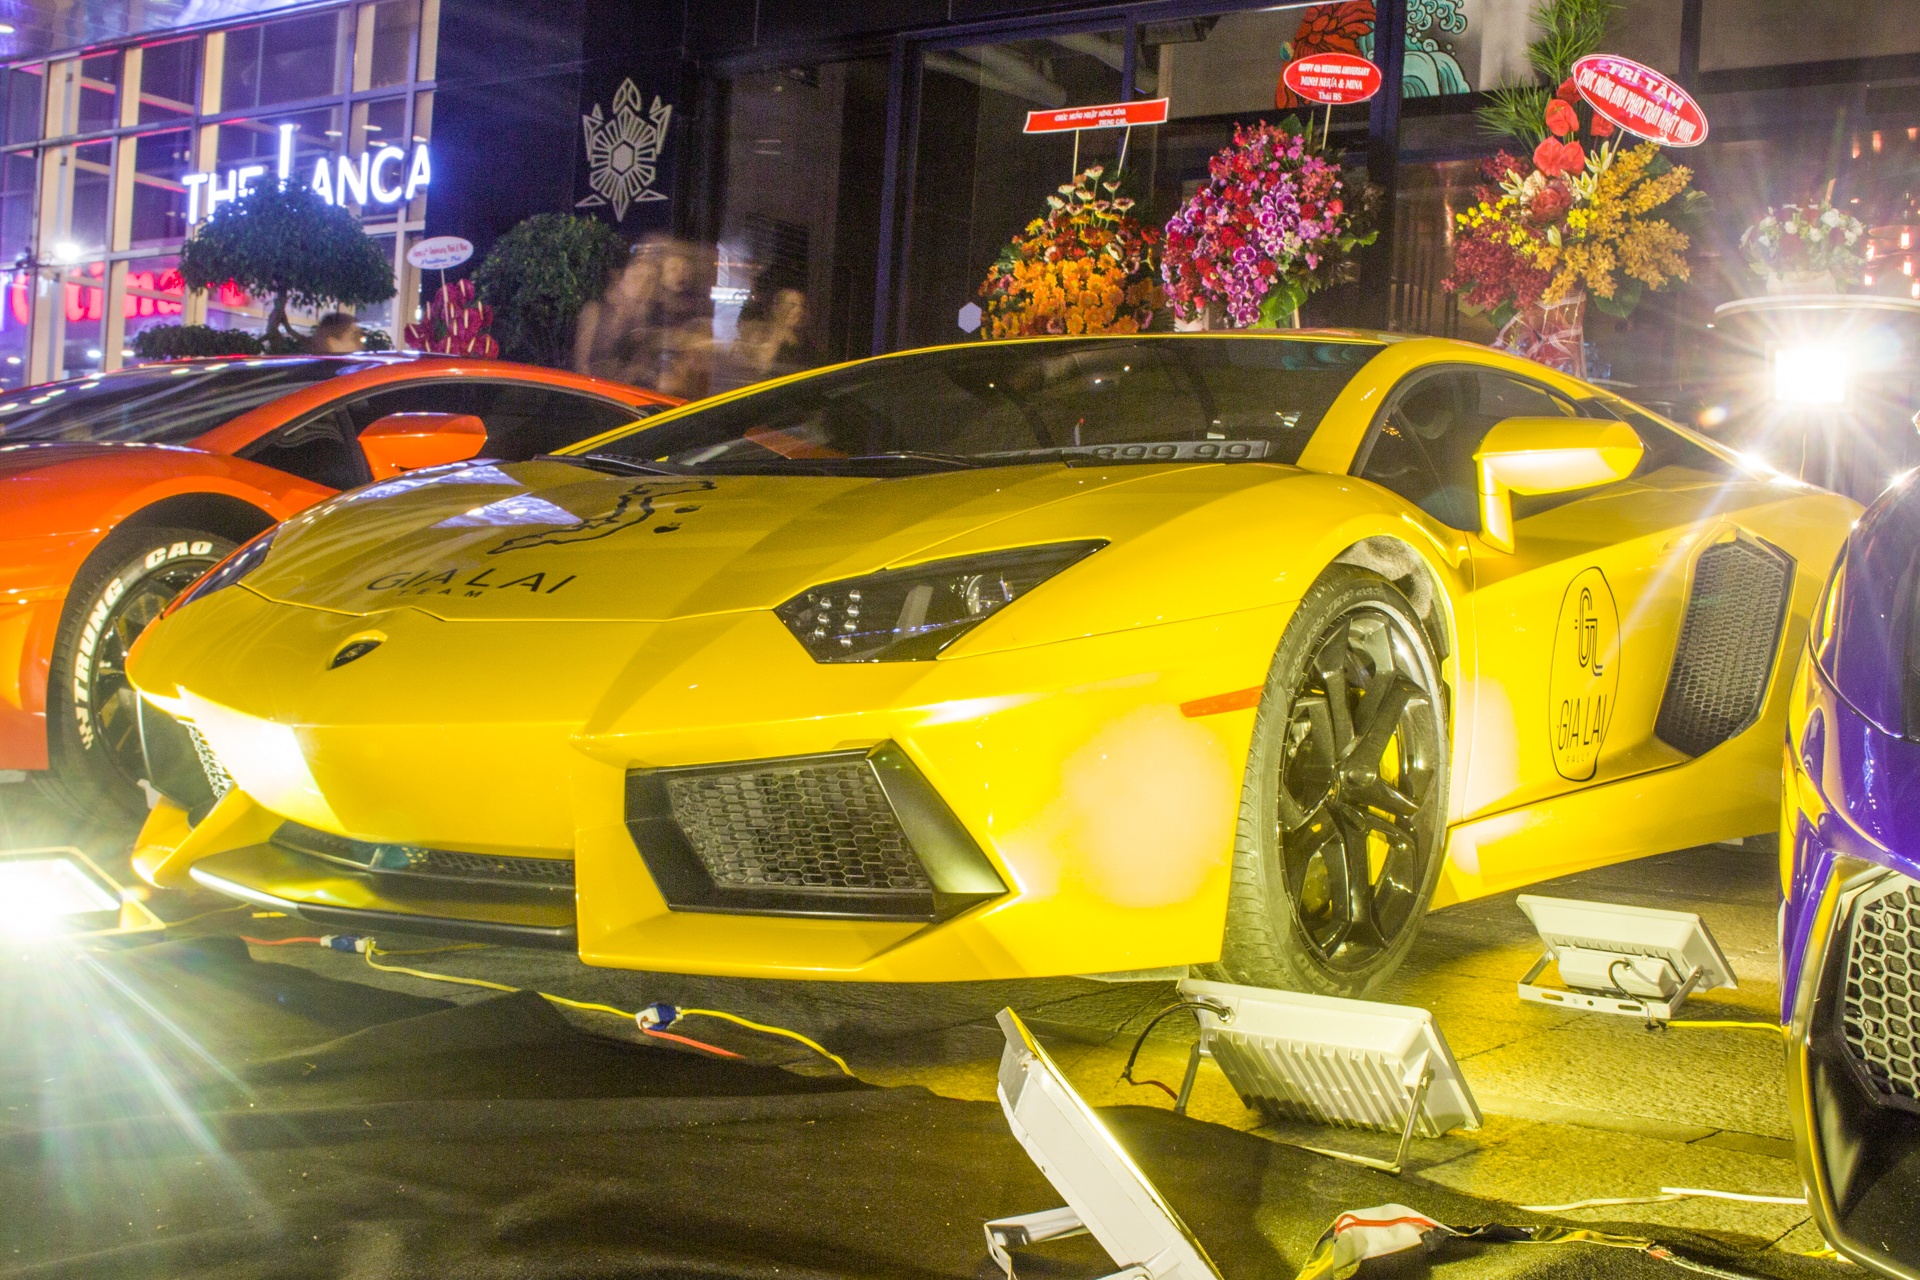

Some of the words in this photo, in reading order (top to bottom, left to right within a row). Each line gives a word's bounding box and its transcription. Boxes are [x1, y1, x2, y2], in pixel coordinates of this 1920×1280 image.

[1300, 76, 1319, 87] MINH
[1345, 79, 1363, 91] MINA
[366, 568, 458, 591] GIA
[464, 567, 577, 594] LAI
[73, 577, 125, 704] TRUNG
[144, 541, 213, 571] CAO
[1557, 698, 1581, 751] GIA
[1582, 693, 1608, 746] LAI
